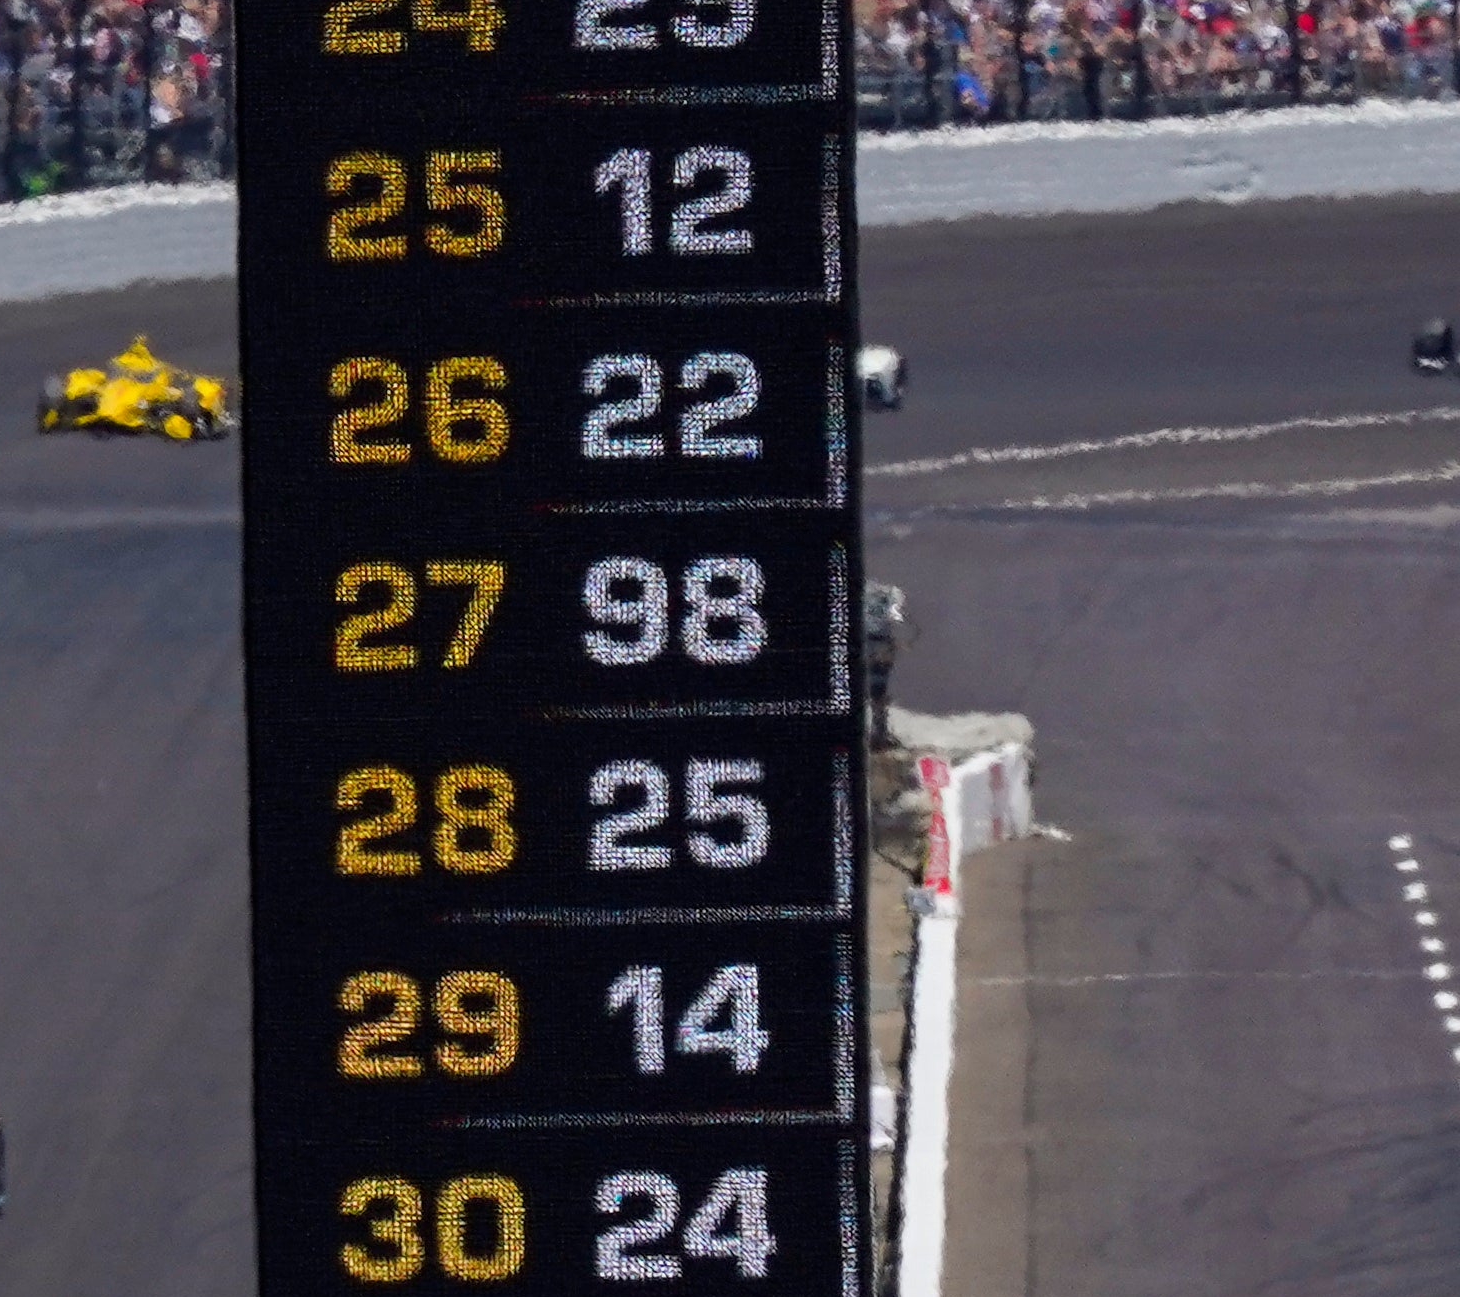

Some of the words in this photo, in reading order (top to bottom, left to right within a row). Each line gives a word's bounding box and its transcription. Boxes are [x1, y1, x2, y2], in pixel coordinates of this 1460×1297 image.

[323, 149, 504, 260] 25
[590, 142, 754, 256] 12
[326, 353, 510, 465] 26
[576, 347, 763, 460] 22
[330, 558, 507, 672] 27
[577, 552, 769, 667] 98
[332, 762, 517, 876] 28
[584, 755, 772, 872] 25
[335, 967, 521, 1079] 29
[603, 959, 772, 1075] 14
[337, 1172, 527, 1284] 30
[591, 1164, 778, 1282] 24
